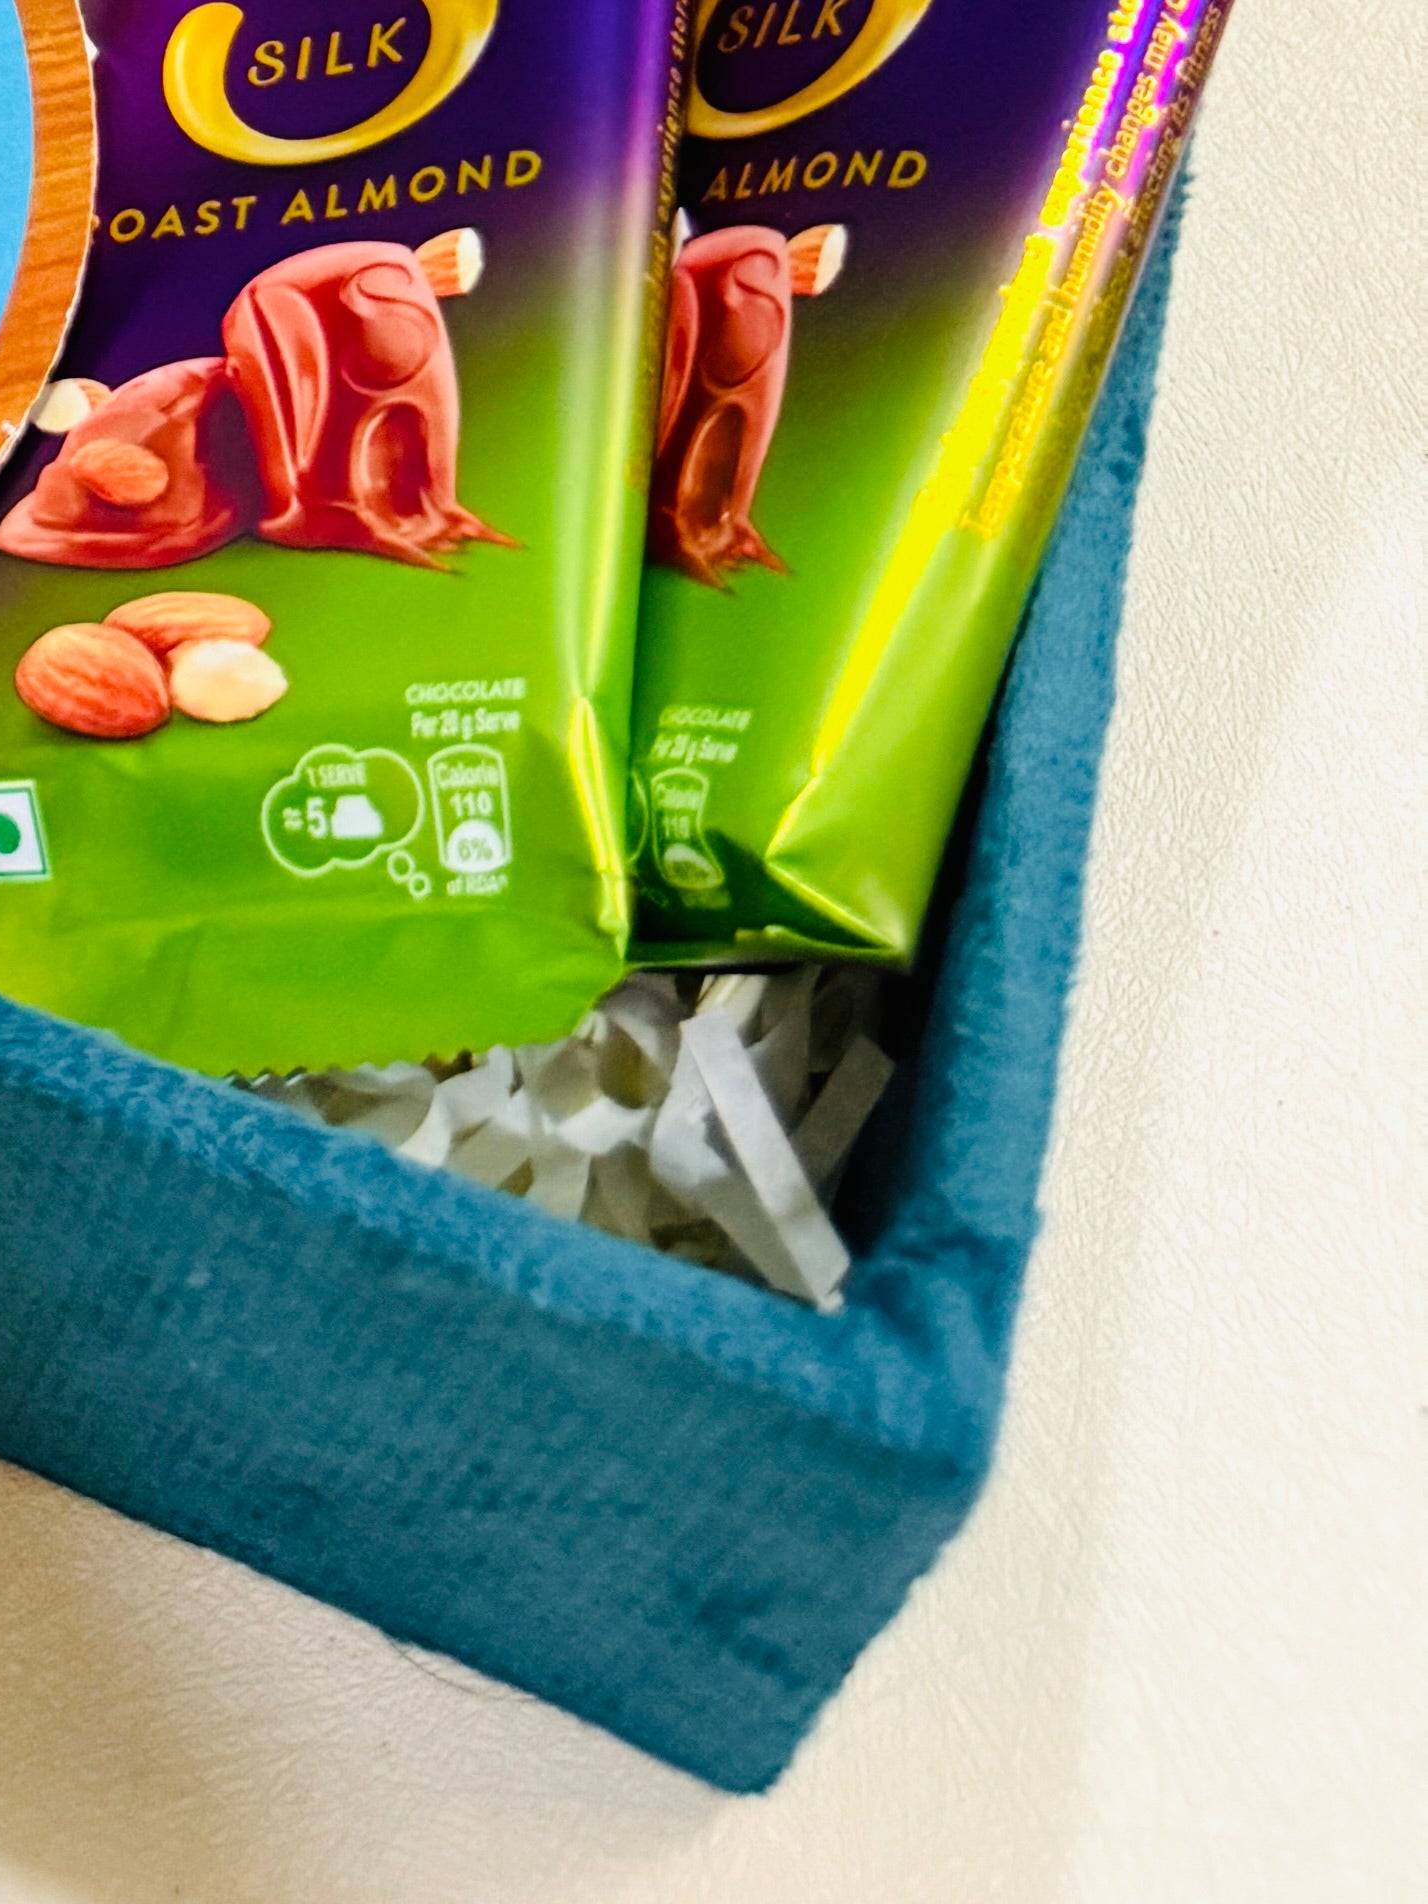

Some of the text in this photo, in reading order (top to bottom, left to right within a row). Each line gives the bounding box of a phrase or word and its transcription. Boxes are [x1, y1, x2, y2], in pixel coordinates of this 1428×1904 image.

[247, 17, 407, 87] SILK
[1140, 10, 1191, 70] may
[1096, 70, 1159, 179] changes
[92, 149, 542, 243] OAST ALMOND
[701, 147, 928, 204] ALMOND
[1046, 178, 1130, 300] humidity
[1035, 298, 1073, 358] and
[404, 677, 527, 705] CHOCOLATE
